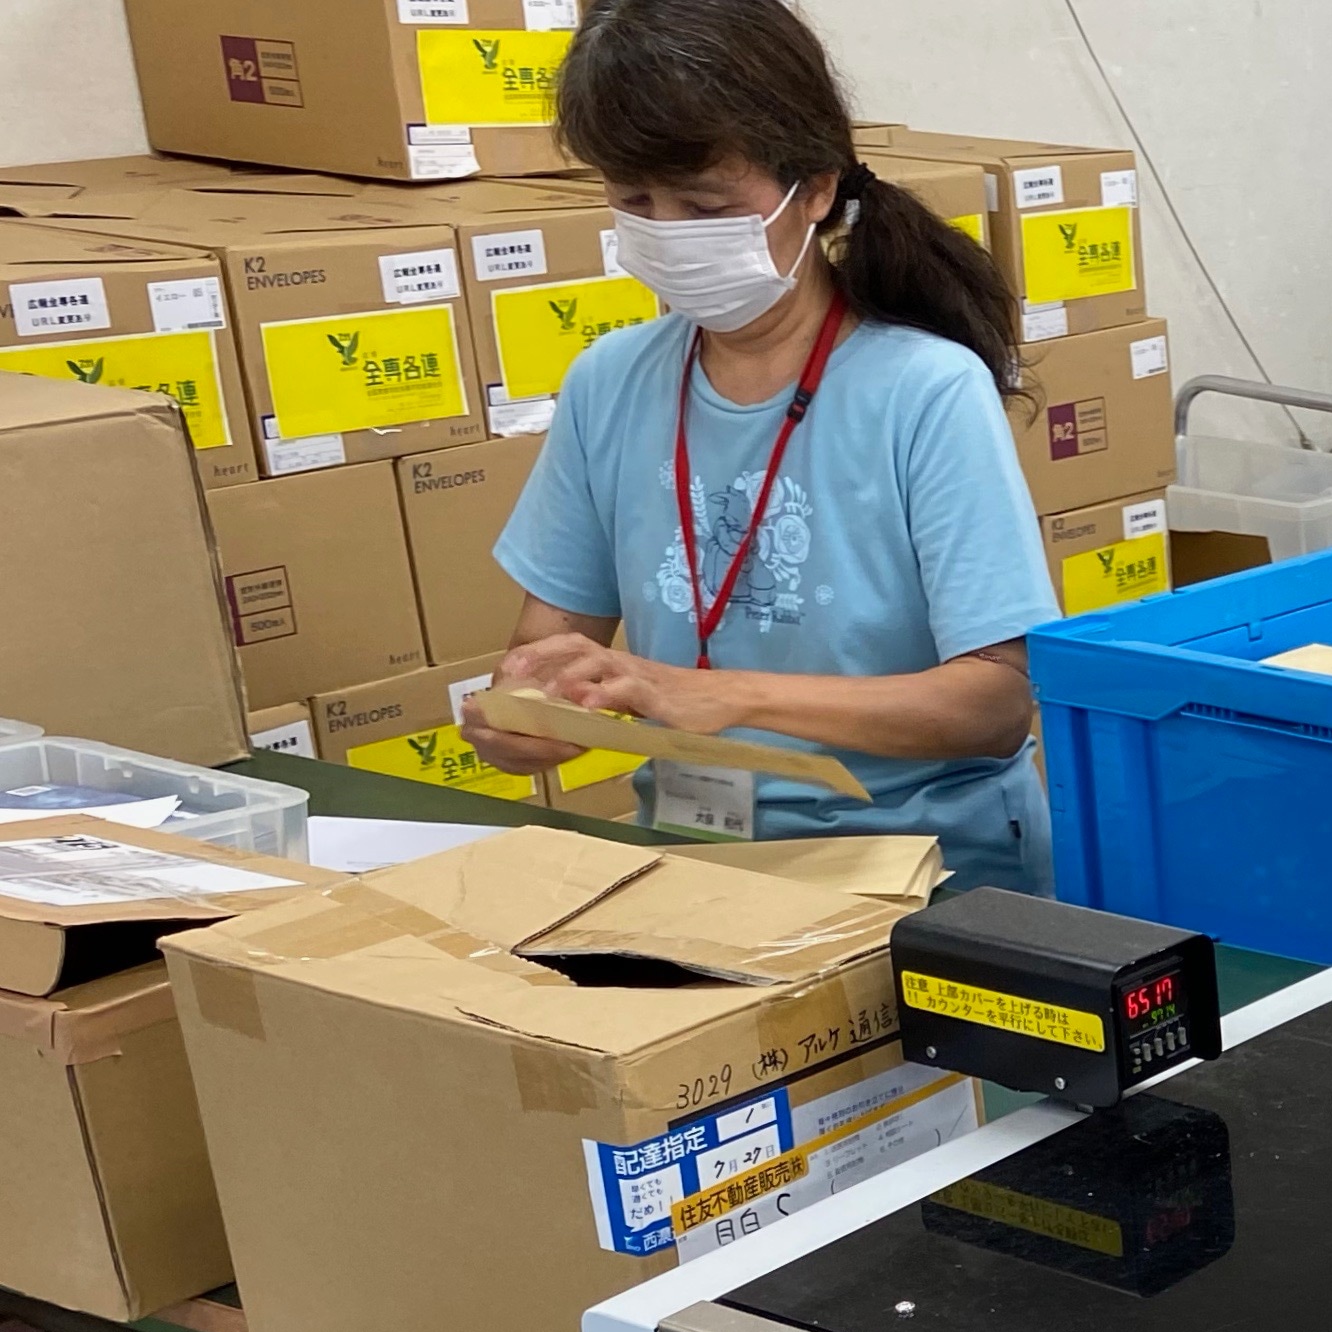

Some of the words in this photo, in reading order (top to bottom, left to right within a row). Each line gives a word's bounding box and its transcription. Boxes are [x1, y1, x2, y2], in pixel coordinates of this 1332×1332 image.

[229, 57, 258, 82] 角2
[244, 256, 266, 273] K2
[247, 269, 326, 290] ENVELOPES
[363, 353, 441, 387] 全専各連
[413, 462, 433, 479] K2
[415, 469, 486, 494] ENVELOPES
[326, 700, 347, 718] K2
[328, 704, 404, 733] ENVELOPES
[905, 975, 929, 993] 注意
[1127, 978, 1173, 1019] 6517
[676, 1064, 732, 1110] 3029
[612, 1125, 708, 1176] 配達指定
[643, 1225, 676, 1251] 西濃
